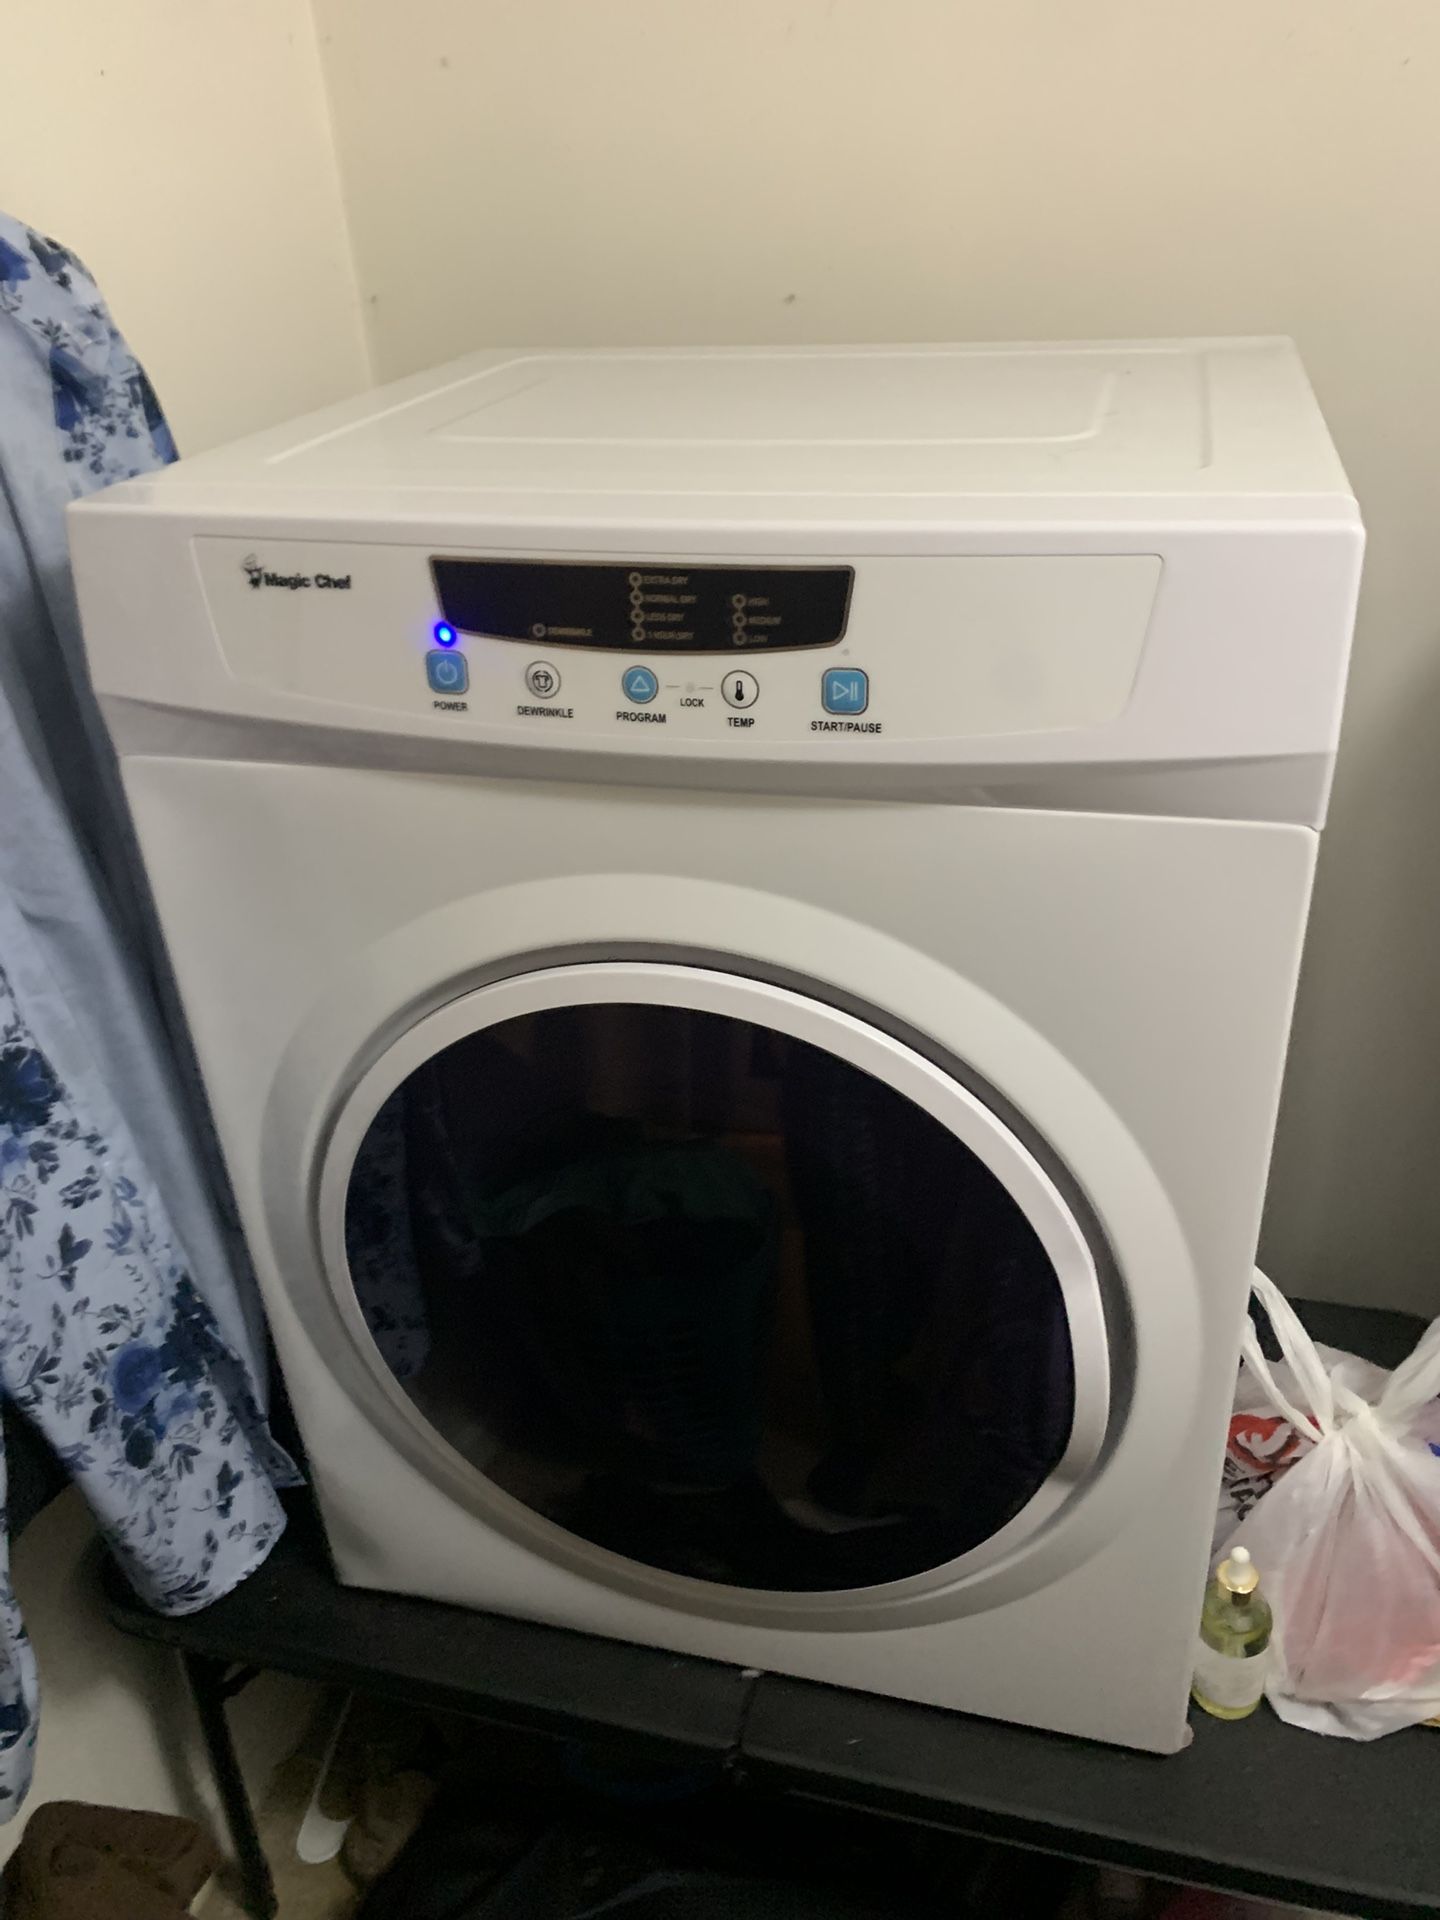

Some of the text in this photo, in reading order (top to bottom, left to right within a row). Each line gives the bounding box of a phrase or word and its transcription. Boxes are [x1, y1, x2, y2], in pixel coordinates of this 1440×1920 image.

[263, 572, 351, 590] Magic Chef
[433, 700, 468, 712] POWER
[680, 697, 705, 708] LOCK
[517, 705, 574, 719] DEWRINKLE
[616, 711, 667, 723] PROGRAM
[727, 717, 755, 728] TEMP
[810, 721, 882, 734] START/PAUSE
